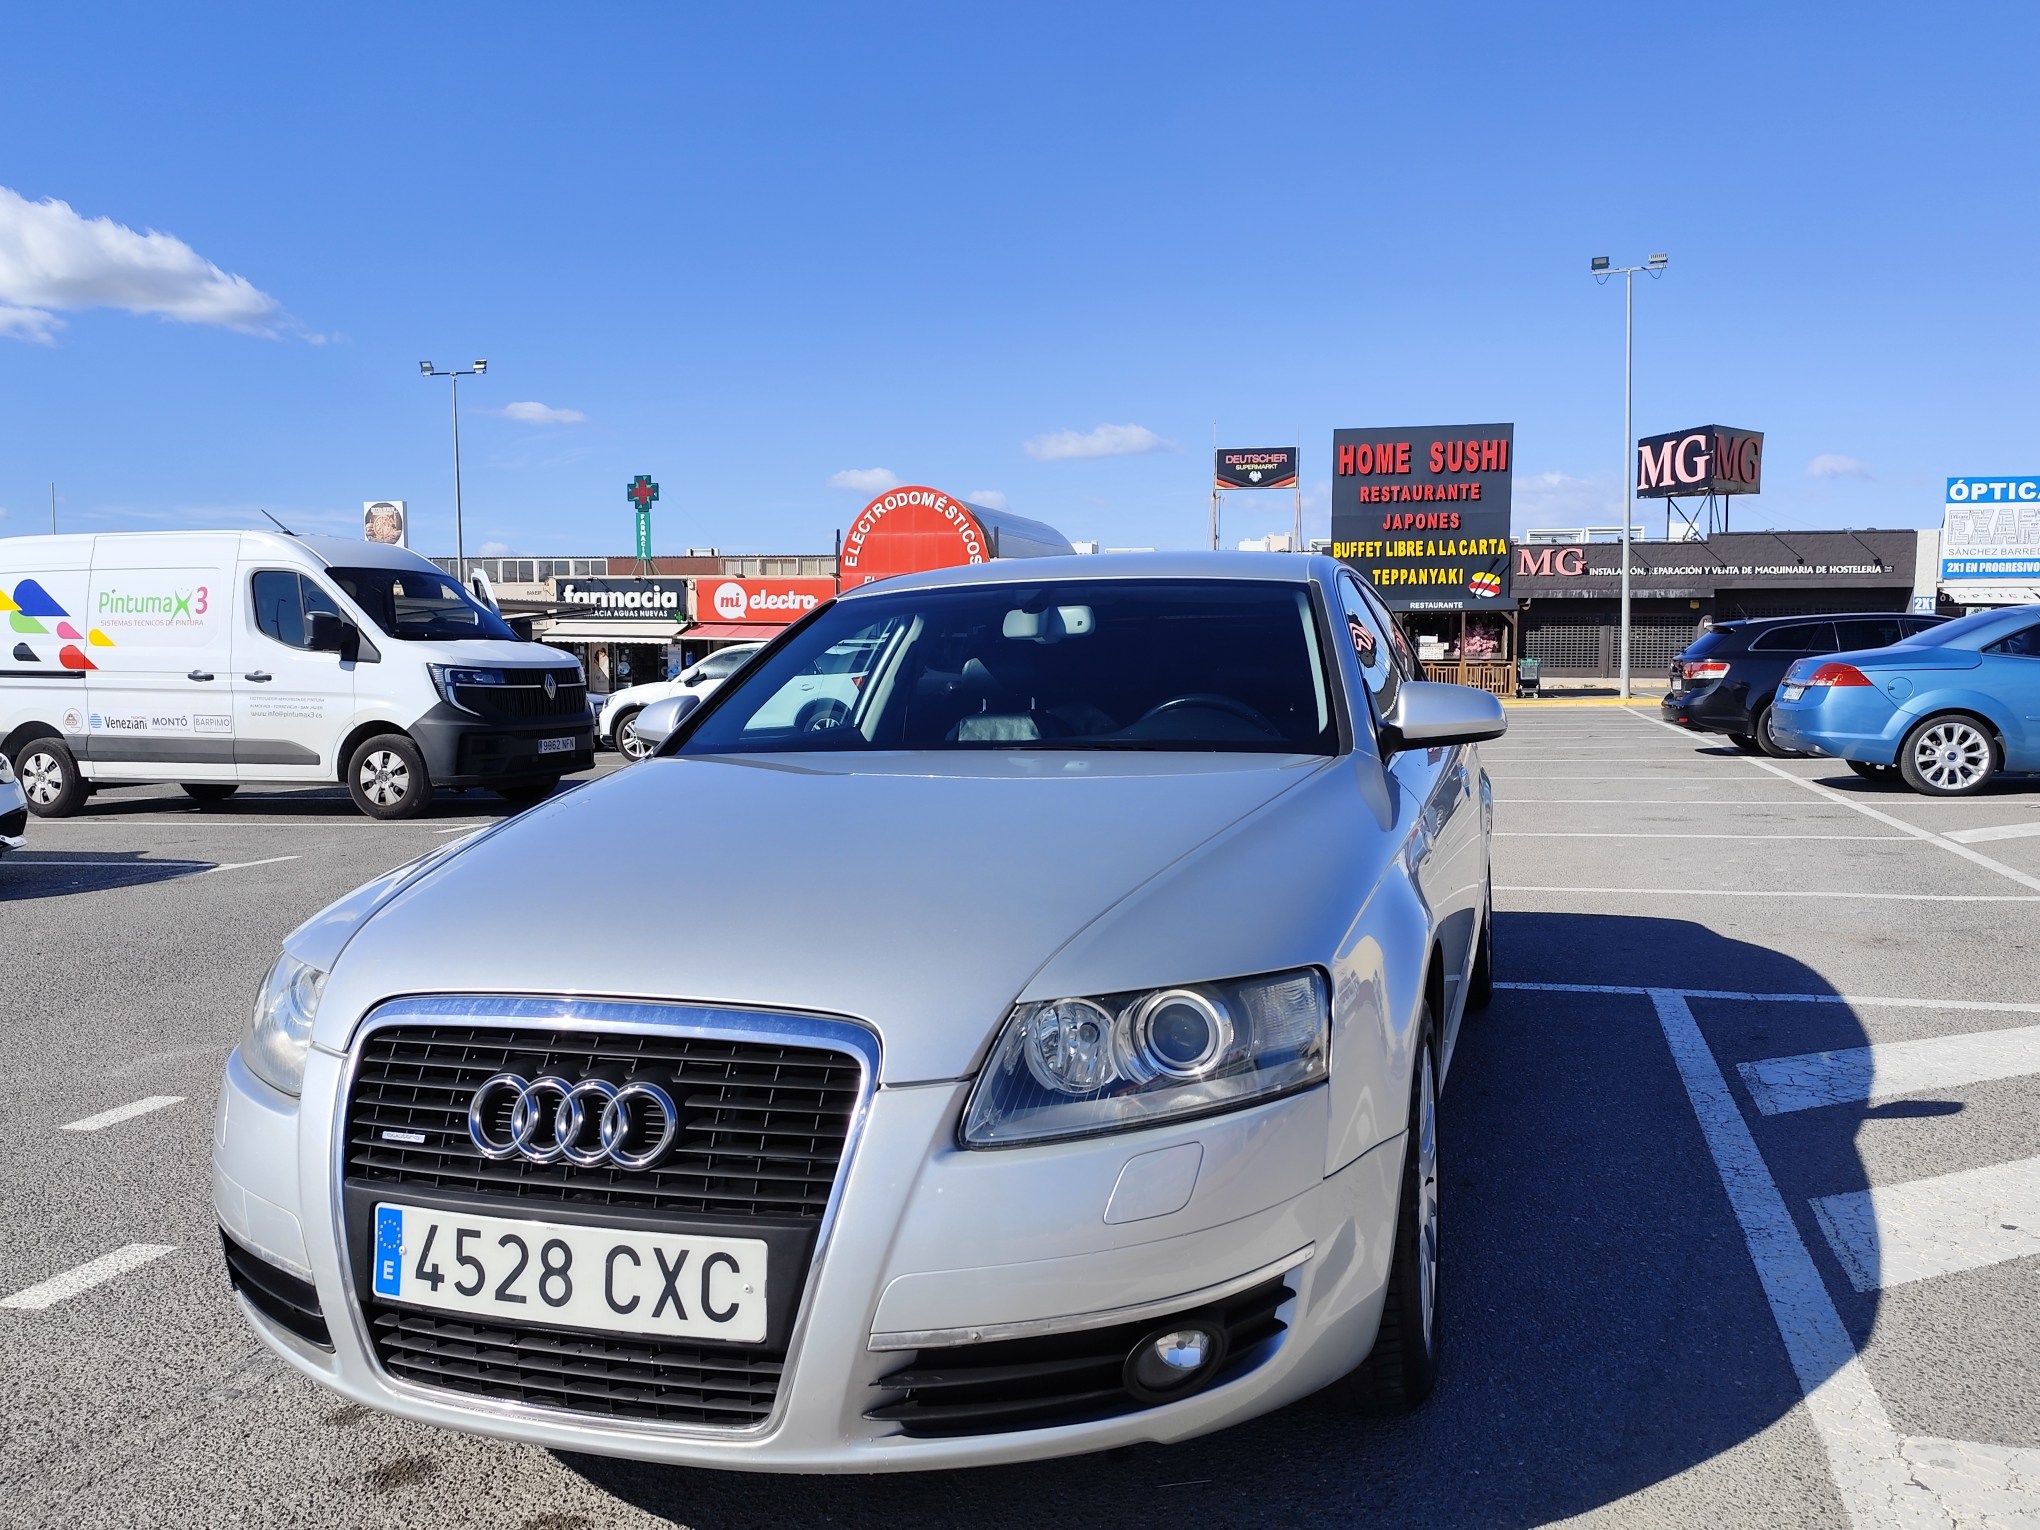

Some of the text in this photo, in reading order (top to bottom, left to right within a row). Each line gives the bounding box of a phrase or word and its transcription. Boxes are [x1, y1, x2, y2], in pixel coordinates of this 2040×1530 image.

[1225, 453, 1288, 464] DEUTSCHER
[1338, 439, 1508, 476] HOME SUSHI
[1638, 434, 1710, 490] MG
[1715, 433, 1760, 485] MG
[1235, 463, 1278, 471] SUPERMARKT
[1359, 483, 1481, 503] RESTAURANTE
[1949, 479, 2040, 501] ÓPTIC
[844, 490, 983, 568] ELECTRODOMÉSTICOS
[1382, 512, 1461, 530] JAPONES
[1333, 538, 1507, 559] BUFFET LIBRE A LA CARTA
[1948, 547, 1998, 556] SÁNCHEZ
[1516, 547, 1588, 577] MG
[1589, 565, 1646, 576] INSTALAÓN,
[1704, 566, 1711, 575] Y
[1712, 566, 1740, 575] VENTA
[1742, 566, 1753, 575] DE
[1755, 565, 1814, 575] MAQUINARIA
[1816, 565, 1827, 574] DE
[1946, 562, 1964, 573] 2X1
[1966, 562, 1978, 573] EN
[1372, 568, 1464, 586] TEPPANYAKI
[563, 584, 678, 608] farmacia
[720, 589, 818, 609] mi electro
[1409, 601, 1464, 609] RESTAURANTE
[1914, 597, 1936, 610] 2X1
[100, 619, 133, 627] SISTEMAS
[165, 619, 175, 627] DE
[175, 618, 204, 627] PINTURA
[613, 609, 638, 618] AGUAS
[640, 609, 668, 618] NUEVAS
[104, 715, 148, 730] Veneziani
[152, 715, 188, 727] MONTÓ
[195, 718, 230, 727] BARPIMO
[383, 1259, 394, 1281] E
[414, 1224, 741, 1324] 4528 CXC
